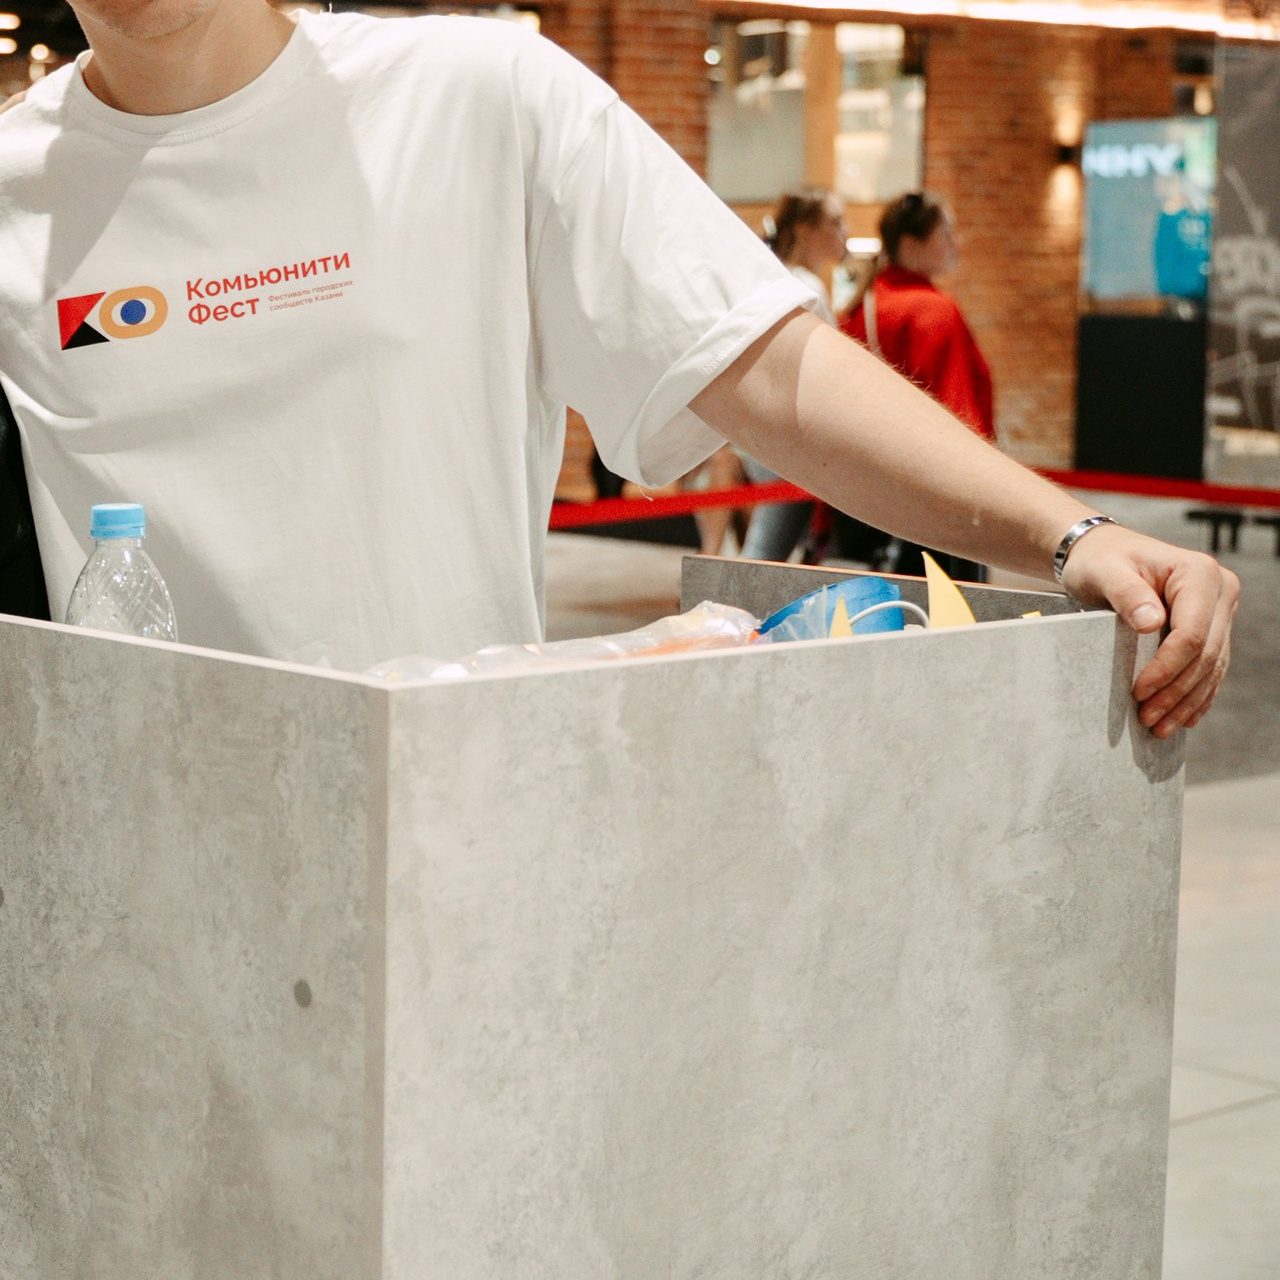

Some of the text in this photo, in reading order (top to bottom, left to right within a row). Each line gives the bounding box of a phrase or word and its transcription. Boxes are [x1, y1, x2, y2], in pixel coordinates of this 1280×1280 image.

[186, 252, 351, 301] Комьюнити
[267, 280, 353, 302] Фестиваль городских
[269, 291, 343, 311] сообществ Казани
[188, 298, 260, 325] Фест
